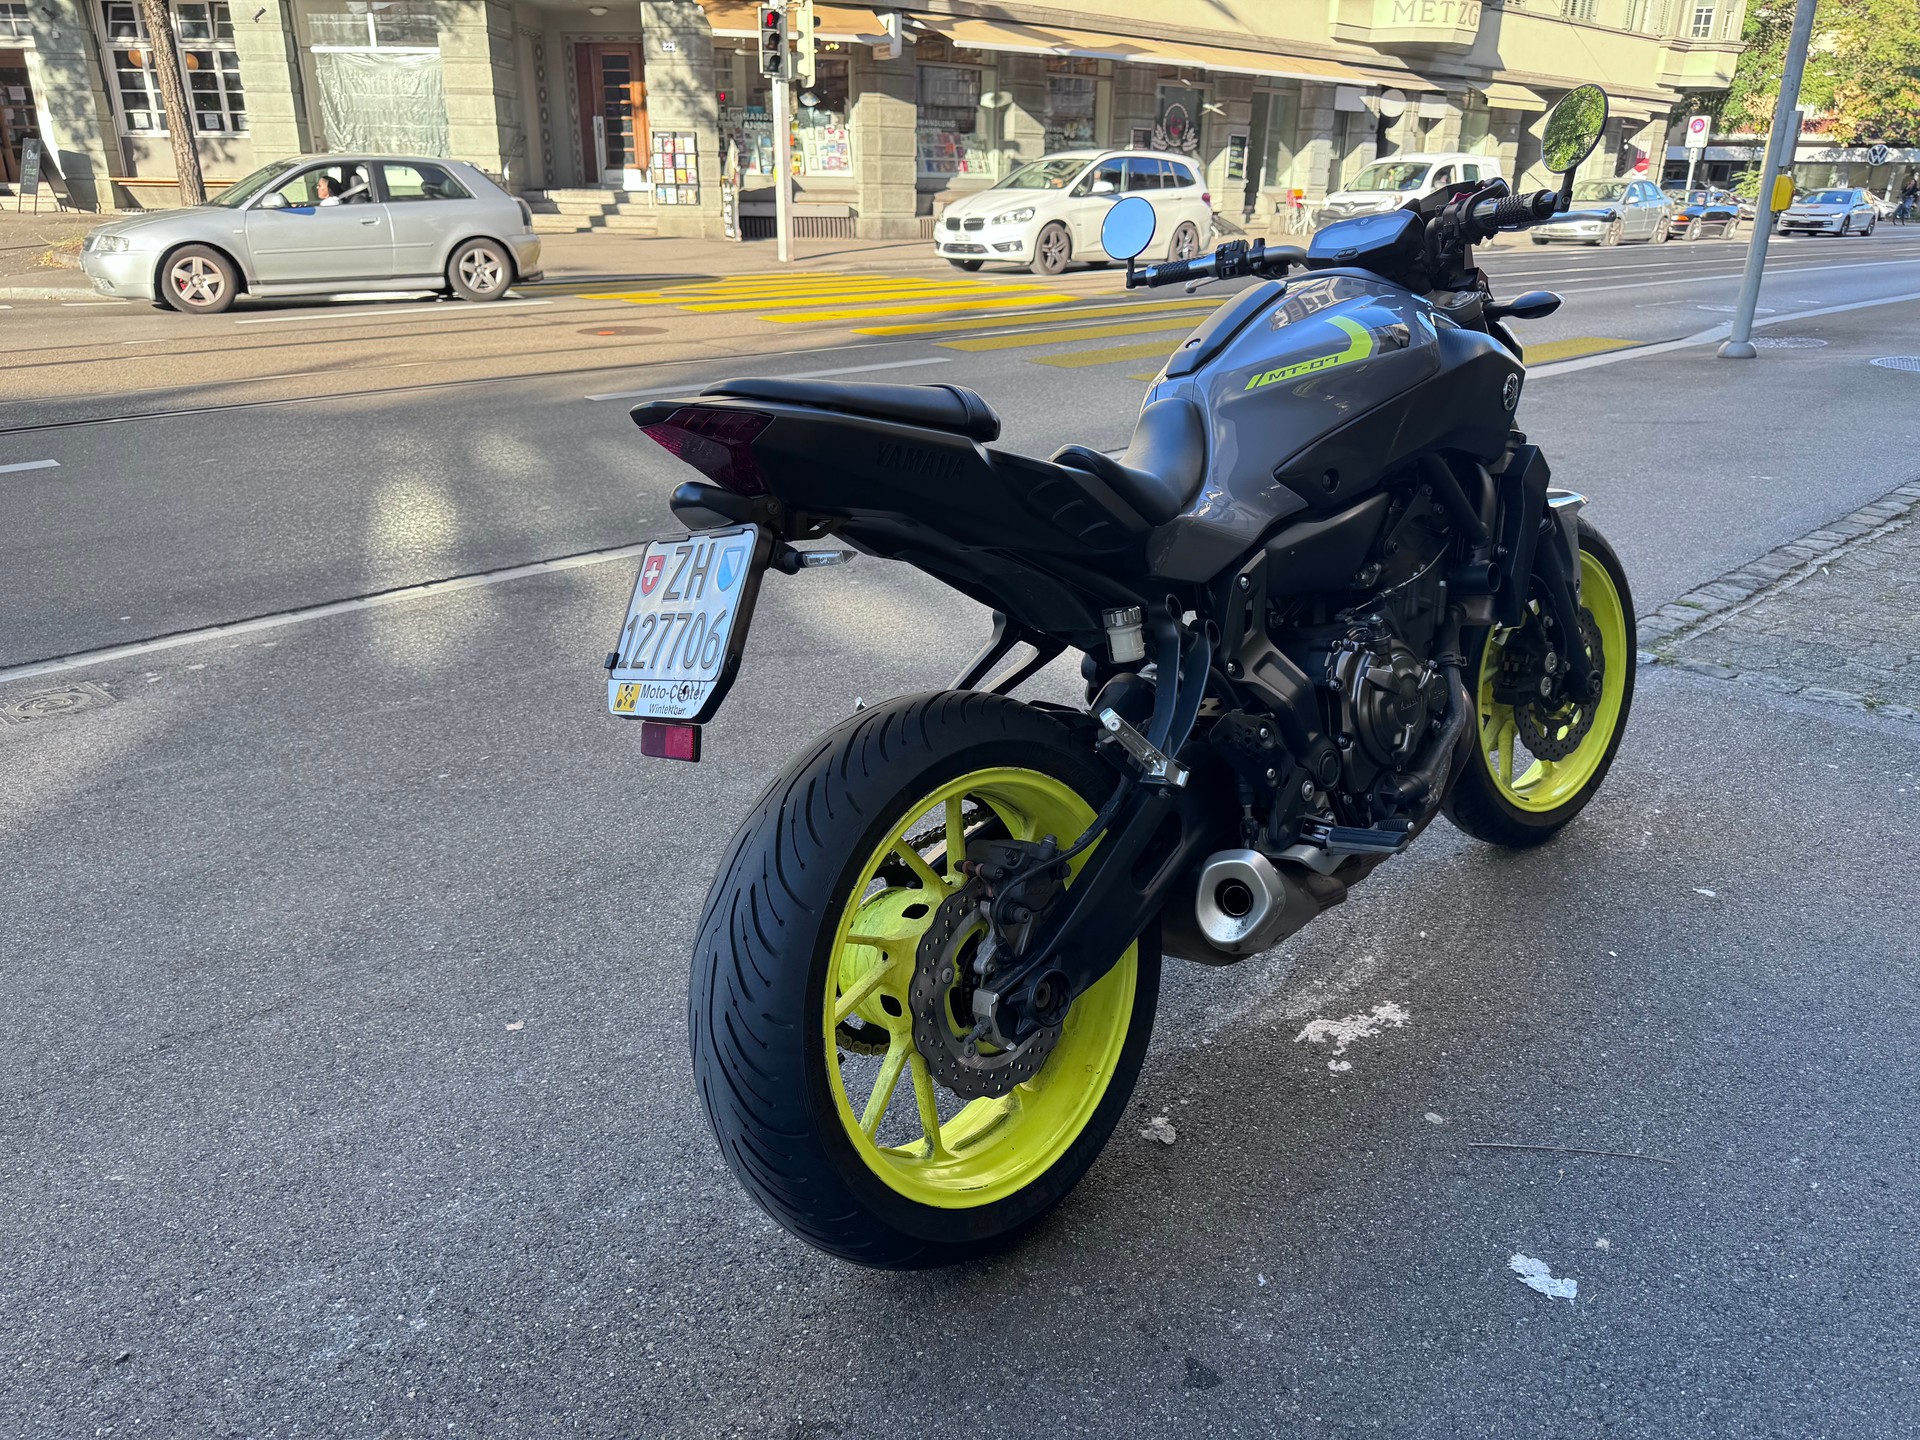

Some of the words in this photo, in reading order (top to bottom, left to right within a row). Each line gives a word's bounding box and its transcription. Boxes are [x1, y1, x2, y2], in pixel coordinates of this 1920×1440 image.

[1268, 355, 1339, 381] MT-07
[876, 440, 966, 481] YAMAHA
[662, 542, 716, 601] ZH
[618, 609, 728, 670] 127706
[640, 684, 705, 701] Moto-Center
